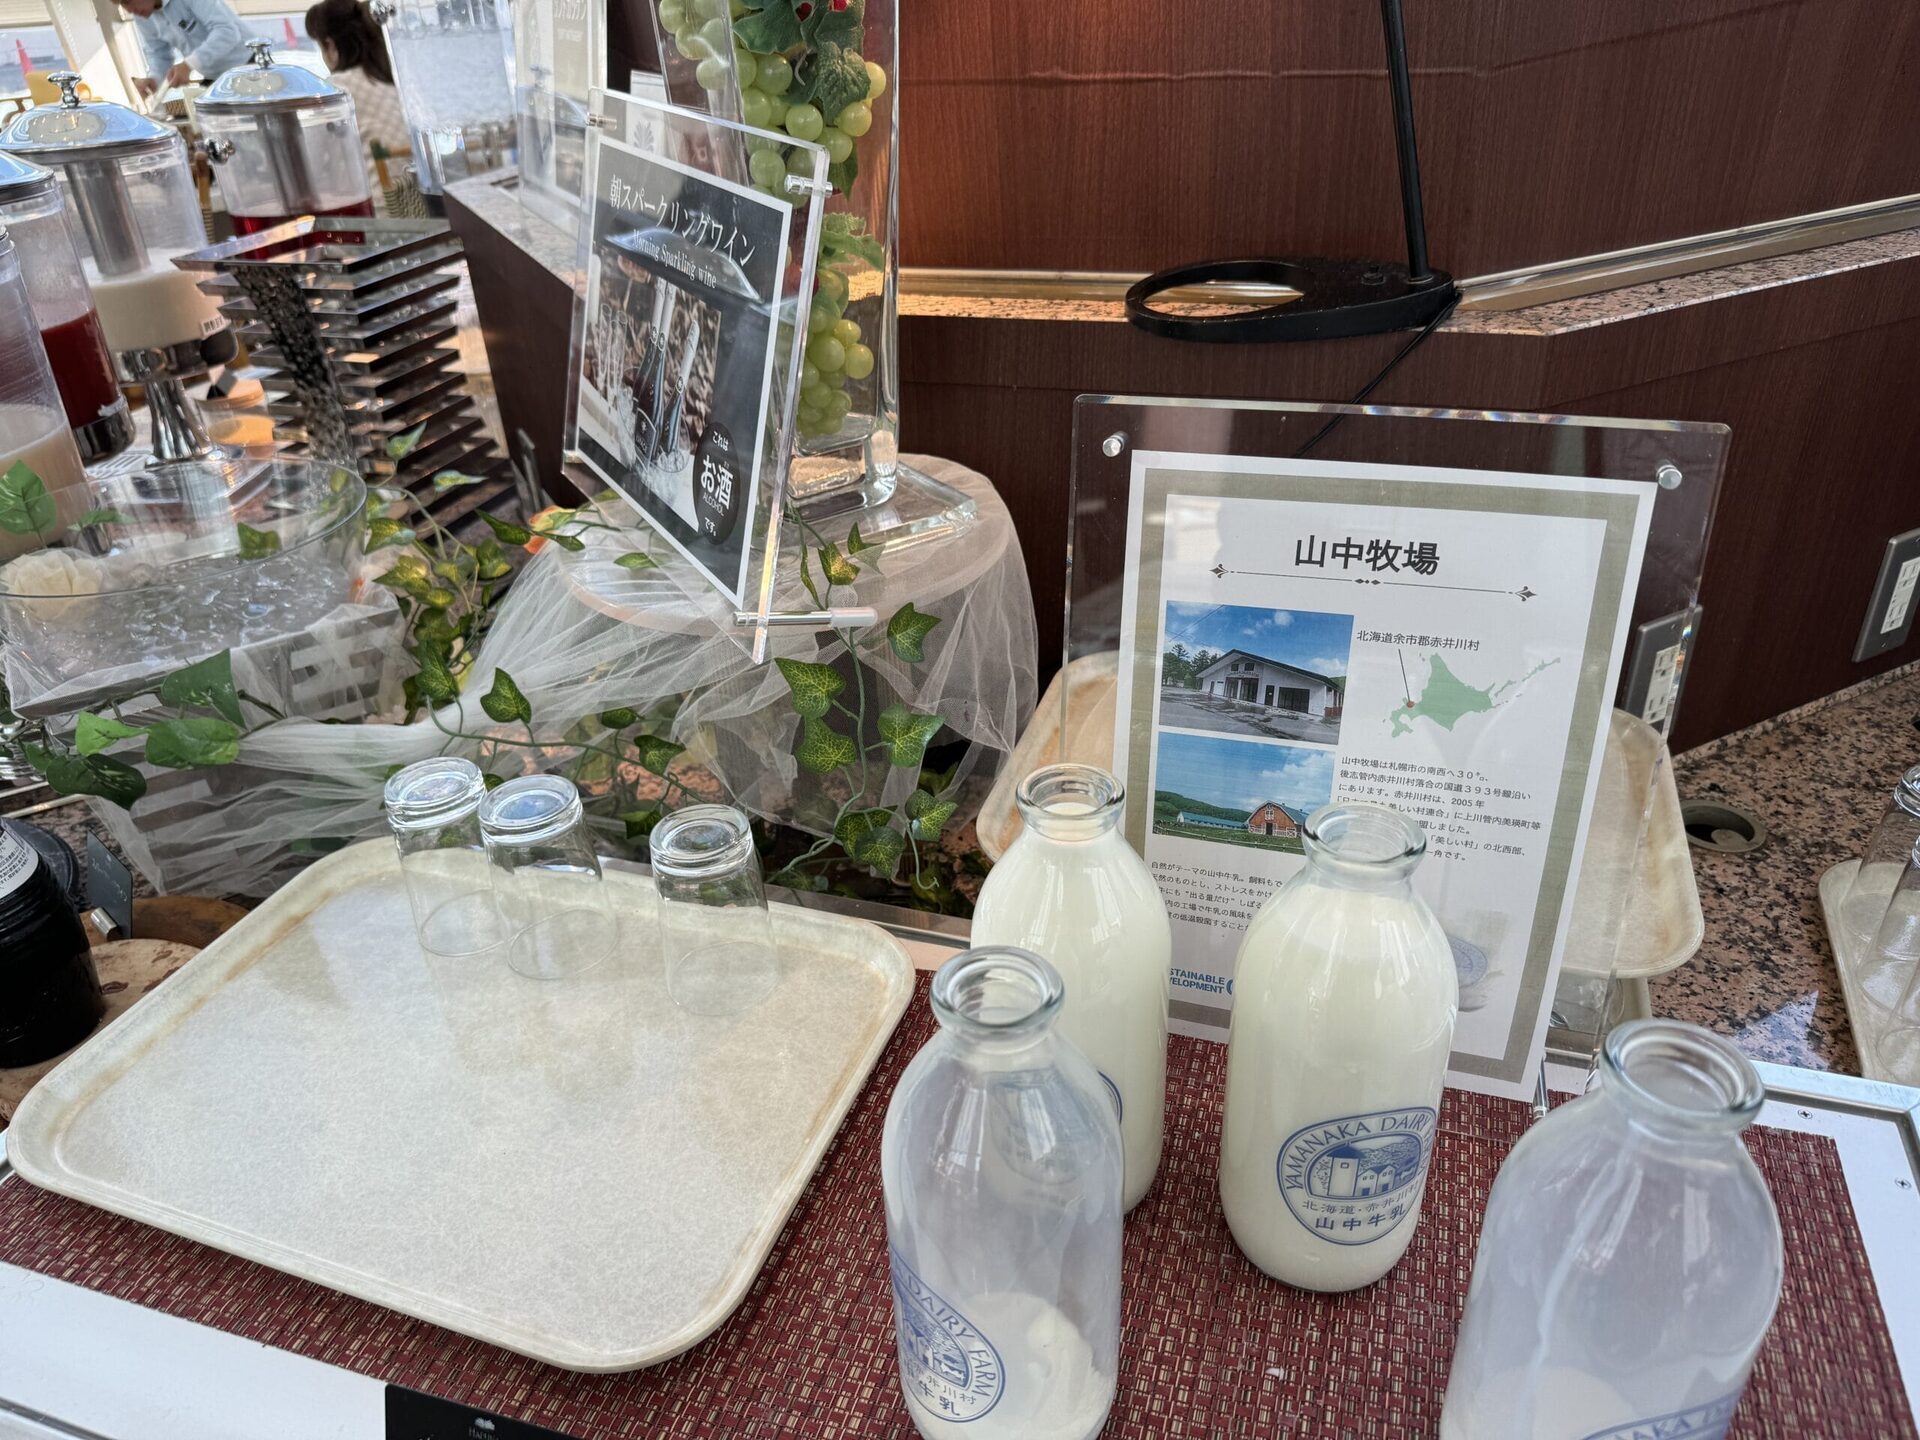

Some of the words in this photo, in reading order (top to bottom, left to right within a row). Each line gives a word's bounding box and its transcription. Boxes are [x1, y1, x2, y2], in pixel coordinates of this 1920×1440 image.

[610, 174, 755, 267] 朝スパークリングワイン
[633, 229, 660, 262] Morning
[661, 244, 696, 280] Sparkling
[698, 266, 717, 289] wine
[713, 431, 728, 452] これは
[701, 455, 734, 510] お酒
[702, 492, 724, 517] ALCOHOL
[705, 517, 717, 536] です。
[1294, 535, 1440, 576] 山中牧場
[1356, 630, 1480, 651] 北海道余市郡赤井川村
[1284, 1121, 1371, 1190] YAMANAKA
[1380, 1113, 1430, 1132] DAIRY
[1315, 1203, 1406, 1231] 山中牛乳
[908, 1275, 975, 1340] DAIRY
[967, 1349, 997, 1397] FARM
